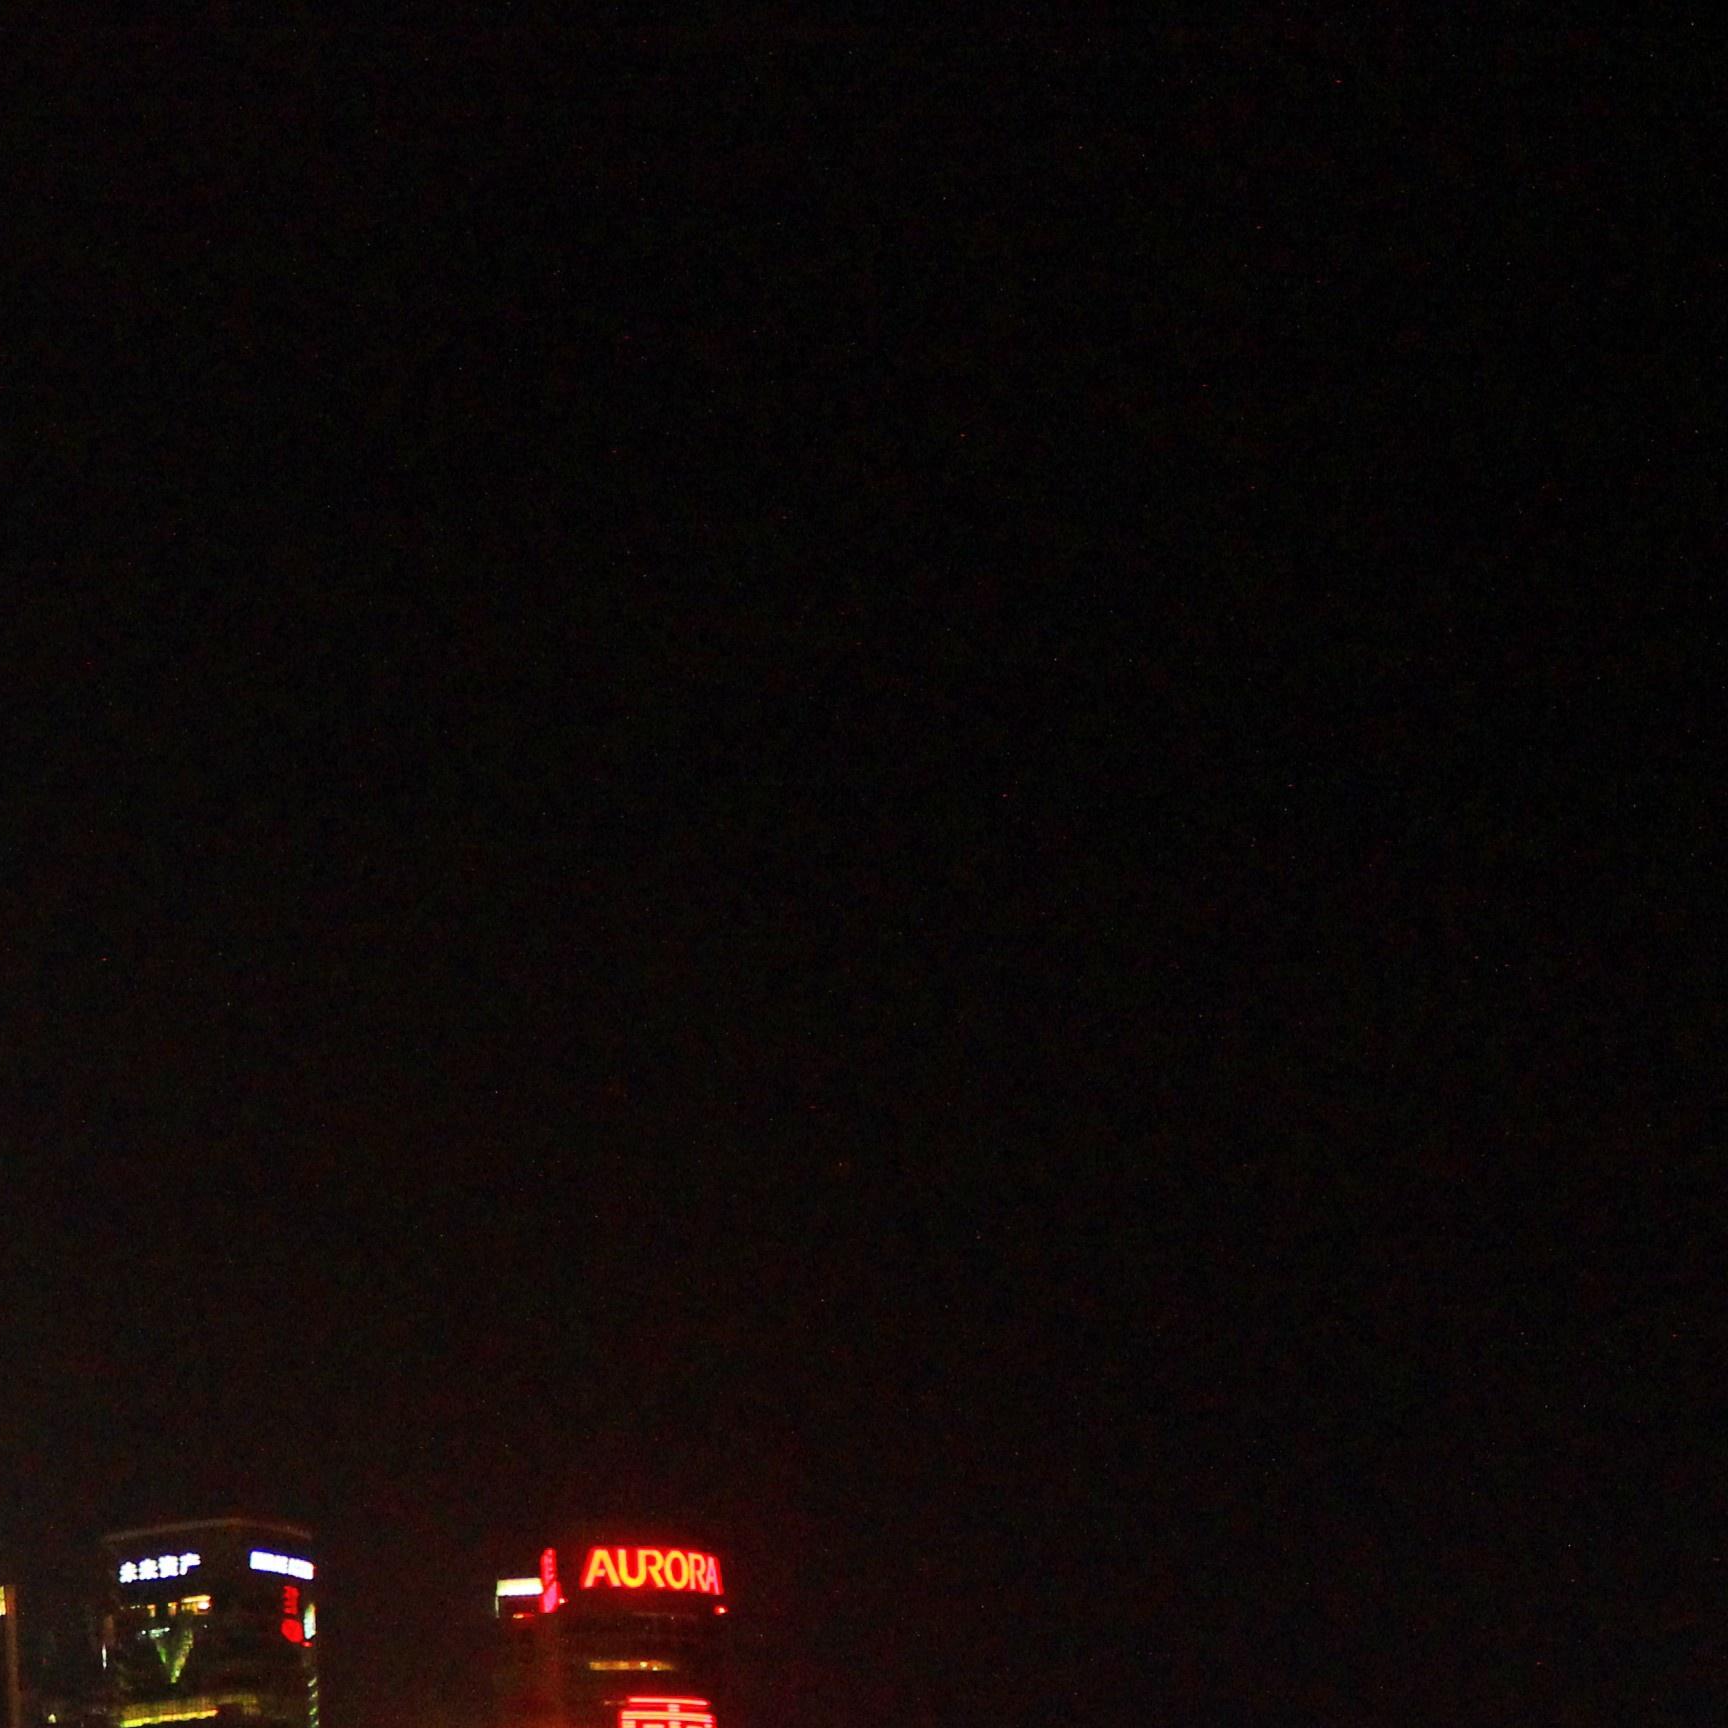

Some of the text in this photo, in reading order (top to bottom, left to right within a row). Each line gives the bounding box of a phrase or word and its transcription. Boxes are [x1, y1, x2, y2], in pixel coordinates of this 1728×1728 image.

[119, 1552, 202, 1584] 未来资产
[581, 1547, 722, 1596] AURORA
